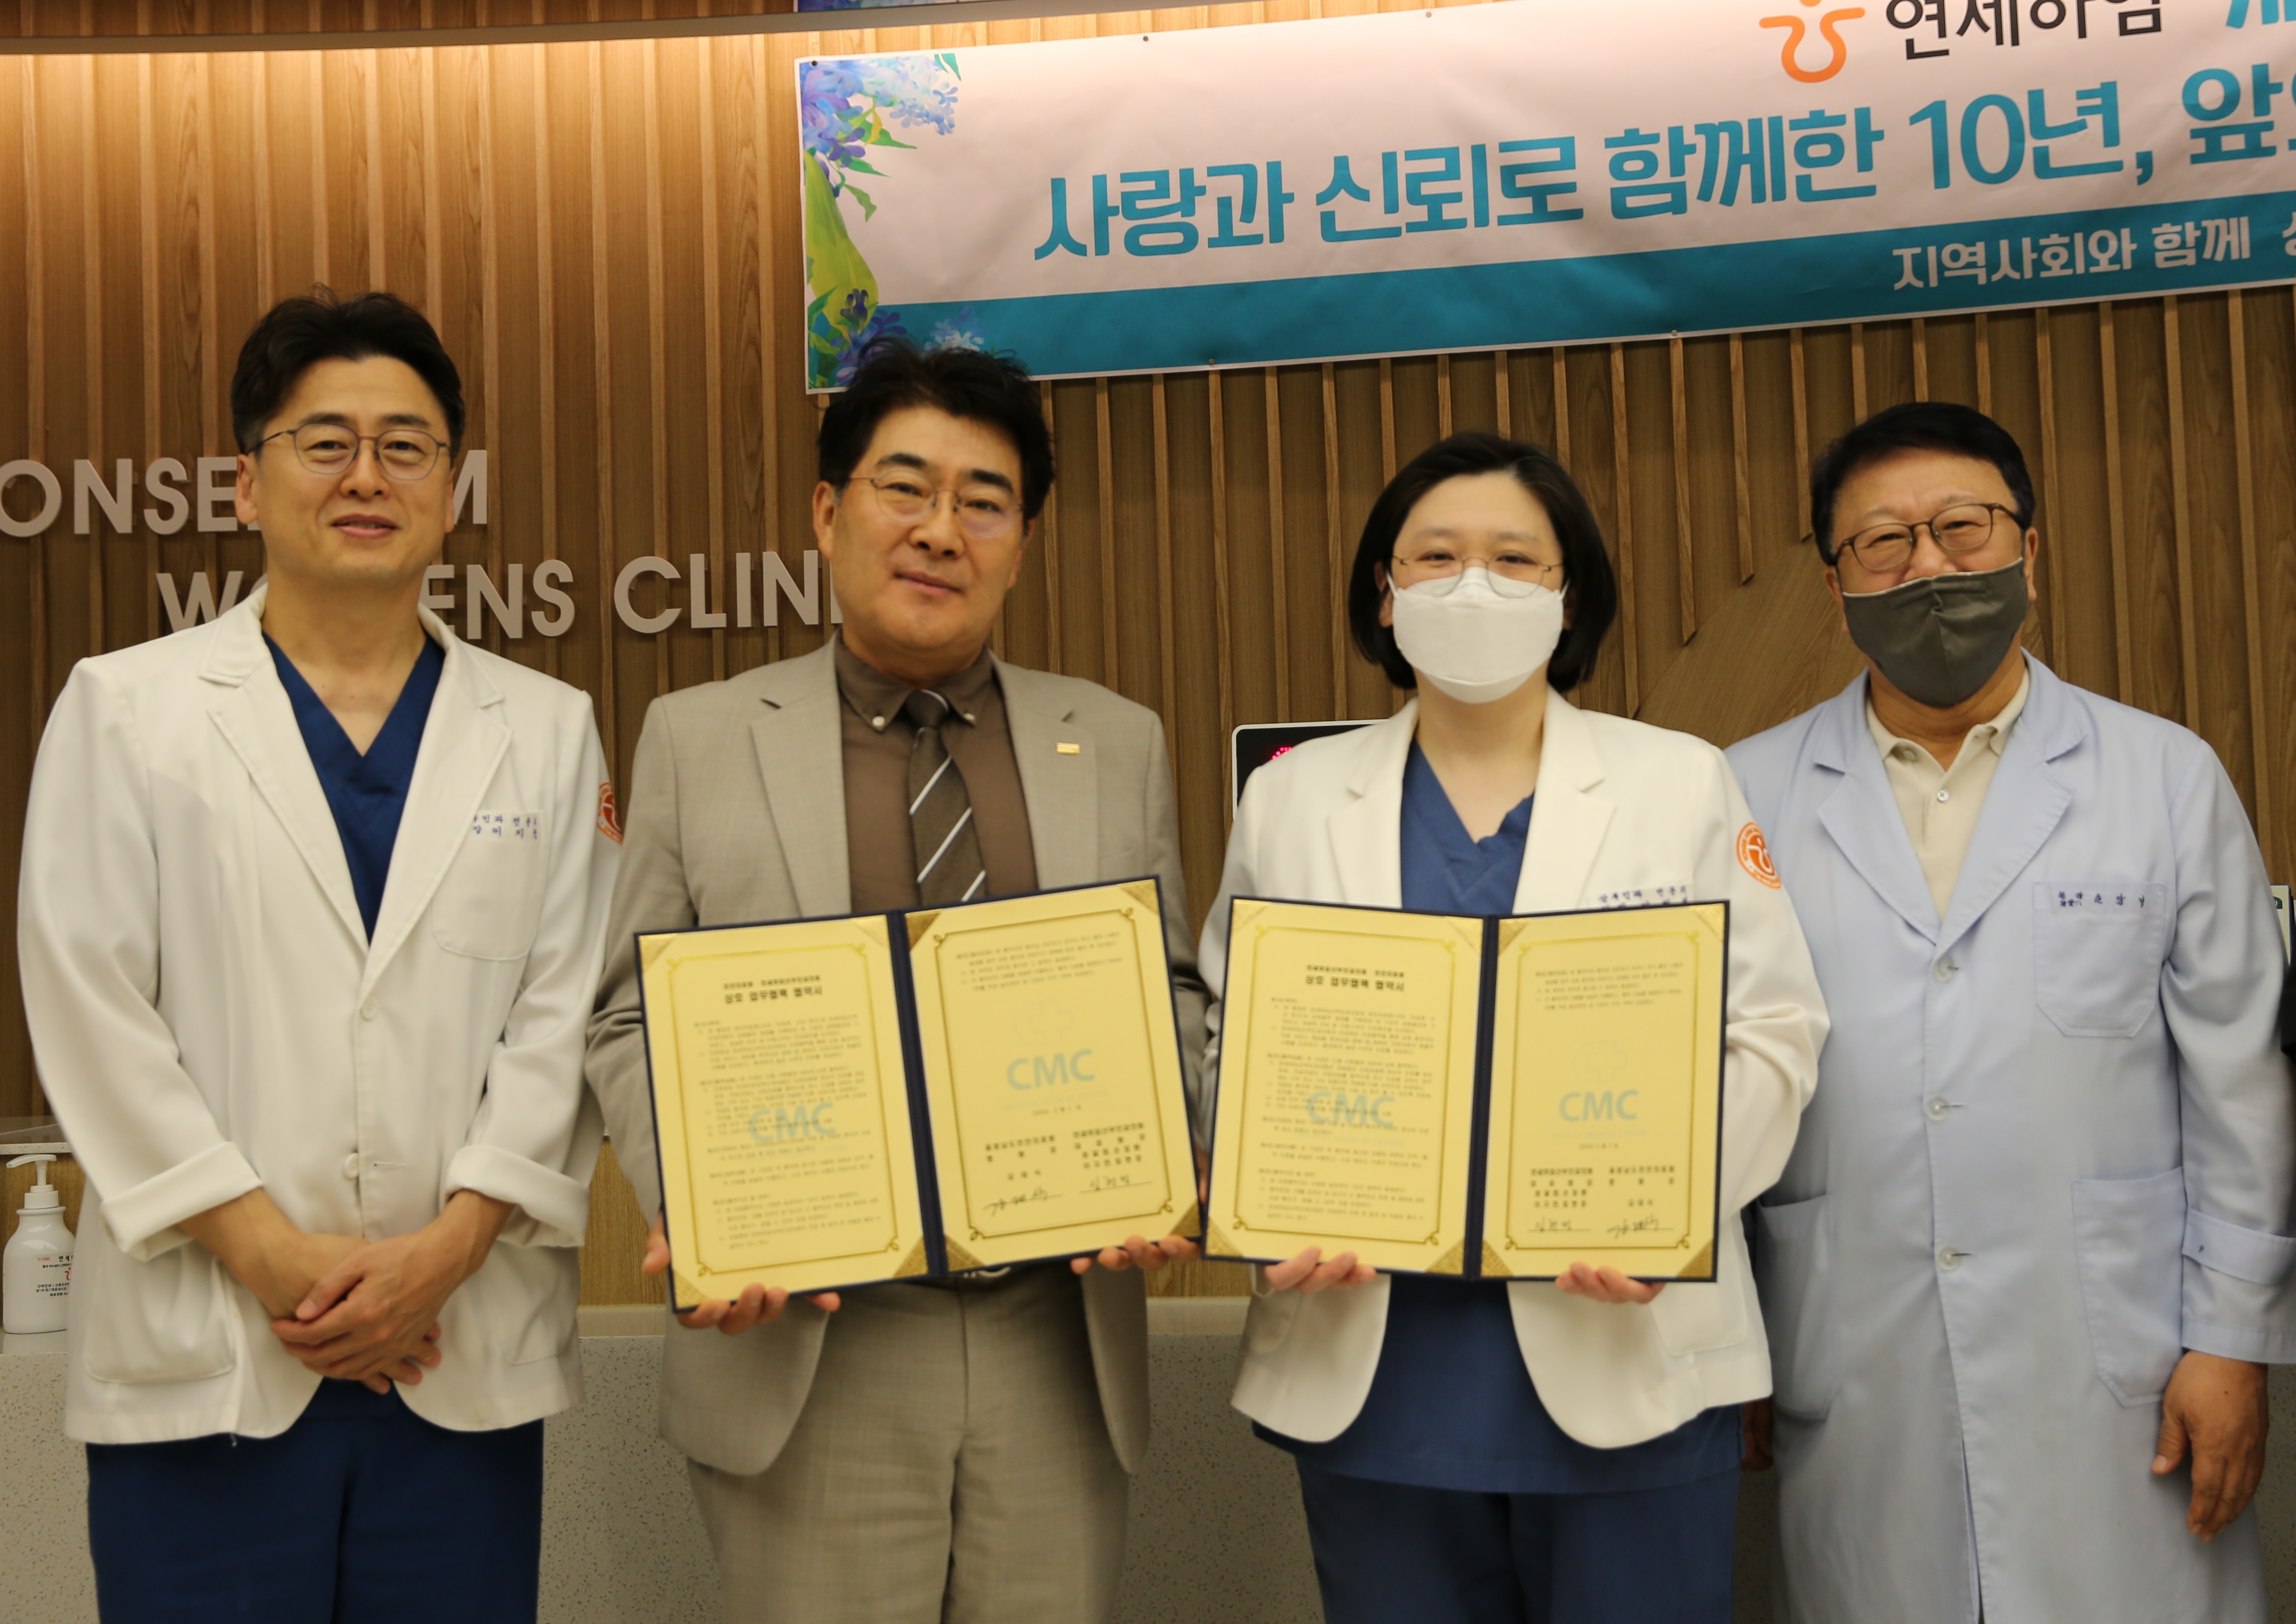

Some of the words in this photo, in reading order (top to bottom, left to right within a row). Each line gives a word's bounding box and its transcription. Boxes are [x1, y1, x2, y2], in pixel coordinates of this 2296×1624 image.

[1034, 161, 1294, 260] 사랑과
[1316, 136, 1585, 243] 신뢰로
[1604, 107, 1884, 220] 함께한
[1908, 81, 2153, 189] 10년,
[2182, 63, 2296, 164] 앞
[1892, 227, 2137, 290] 지역사회와
[2151, 217, 2250, 269] 함께
[0, 457, 264, 538] ONSE
[156, 559, 575, 639] WENS
[1006, 1048, 1096, 1091] CMC
[749, 1101, 837, 1143] CMC
[1306, 1089, 1395, 1128] CMC
[1558, 1089, 1639, 1122] CMC
